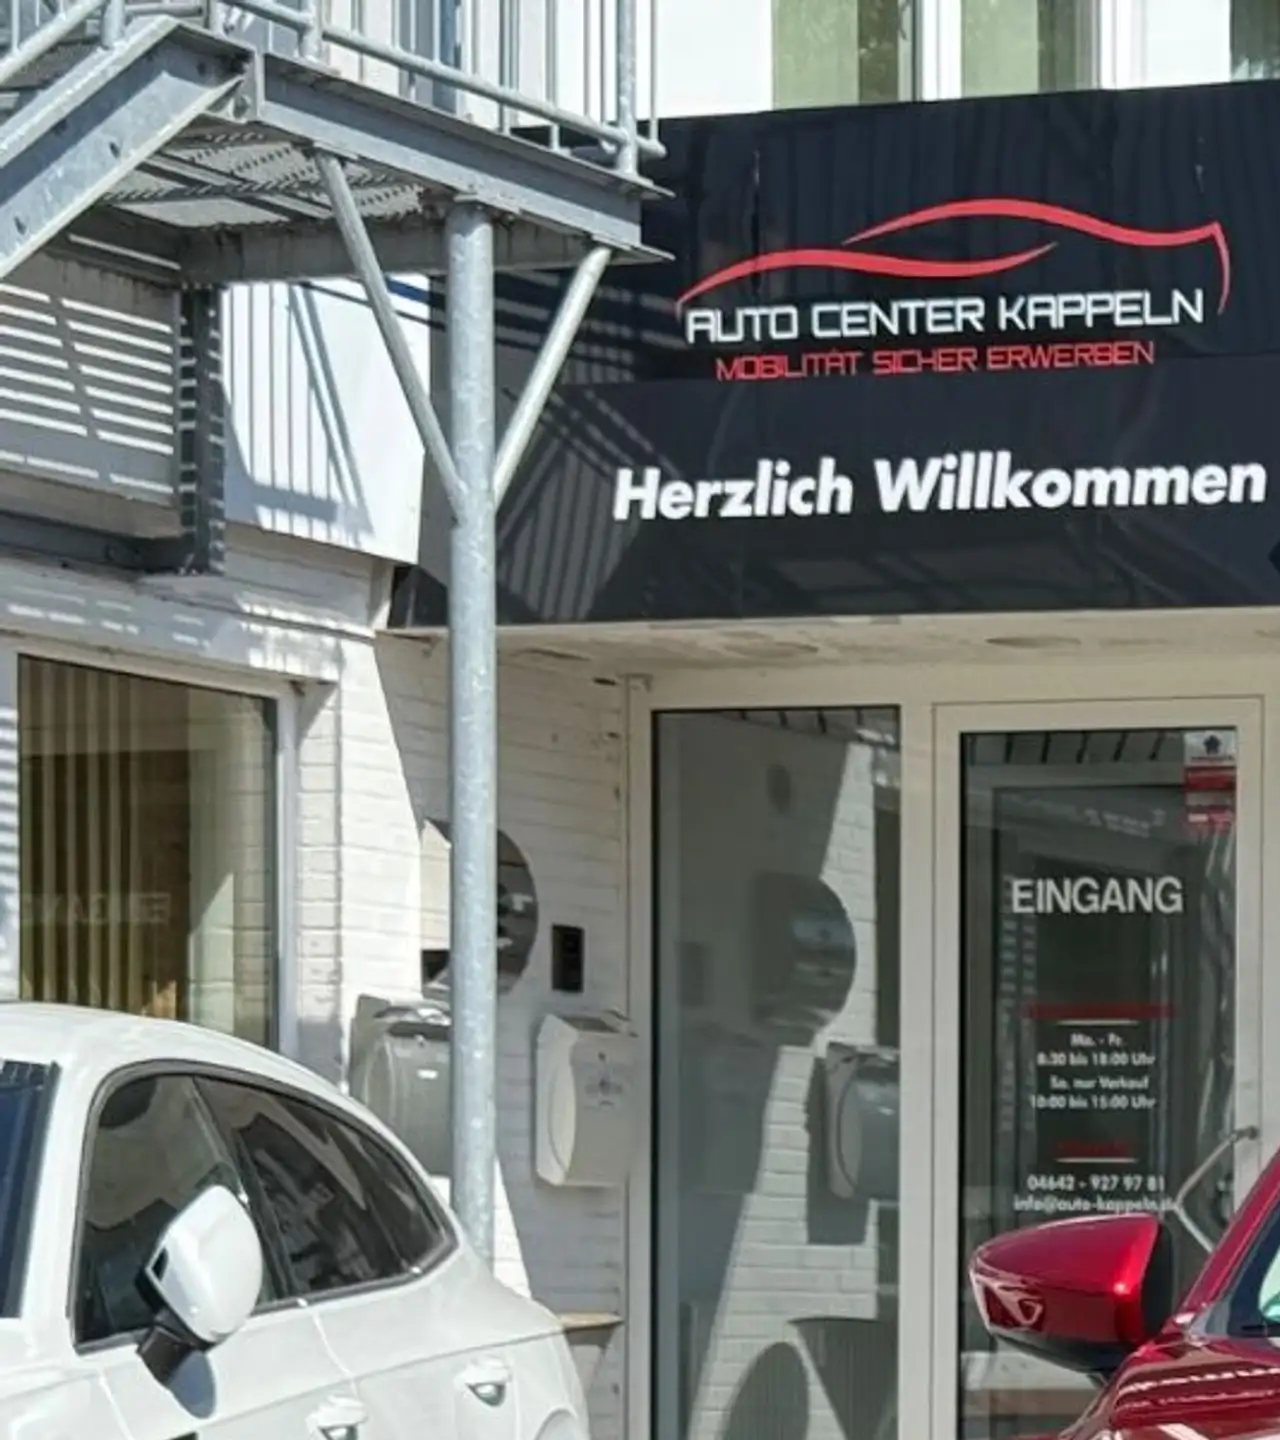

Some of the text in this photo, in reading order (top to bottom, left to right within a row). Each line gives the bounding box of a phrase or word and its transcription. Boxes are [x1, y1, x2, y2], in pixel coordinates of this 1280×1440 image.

[686, 289, 1204, 344] AUTO CENTER KAPPELN
[873, 346, 976, 376] SICHER
[987, 340, 1154, 372] ERWERBEN
[613, 451, 1267, 520] Herzlich Willkommen
[1011, 876, 1184, 914] EINGANG
[1069, 1052, 1088, 1066] bis
[1131, 1052, 1156, 1066] Uhr
[1073, 1079, 1097, 1089] nur
[1099, 1076, 1149, 1089] Verkauf
[1069, 1095, 1088, 1109] bis
[1131, 1095, 1156, 1109] Uhr
